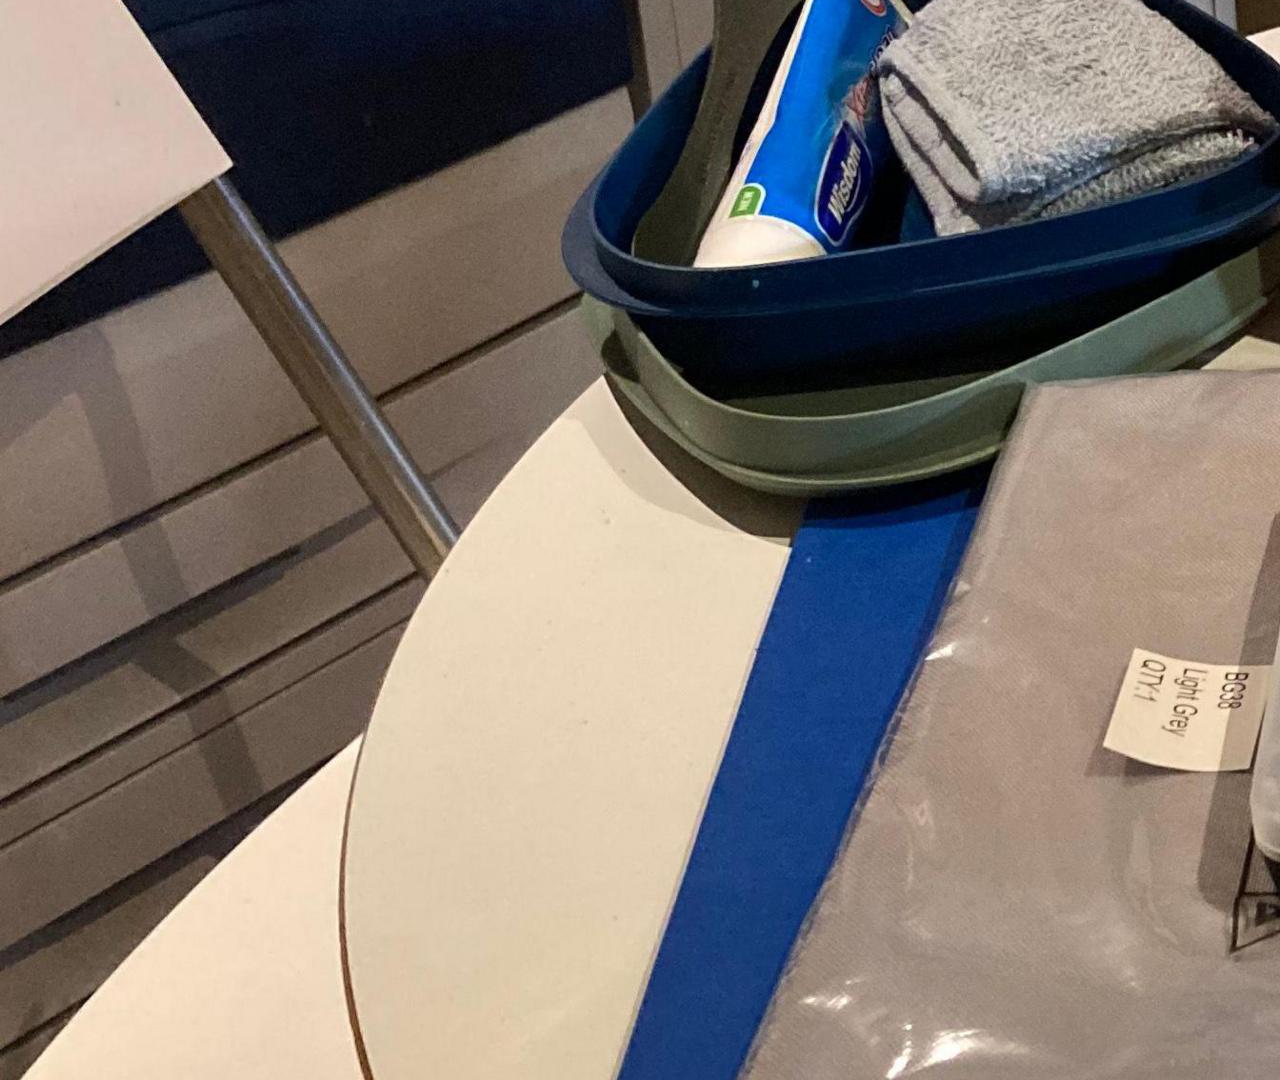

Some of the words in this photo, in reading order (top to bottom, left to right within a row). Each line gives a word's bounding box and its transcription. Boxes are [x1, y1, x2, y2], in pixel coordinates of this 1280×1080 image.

[828, 141, 861, 224] Wisdom
[1174, 668, 1208, 701] Light
[1217, 672, 1249, 710] BG38
[1161, 703, 1198, 737] Grey
